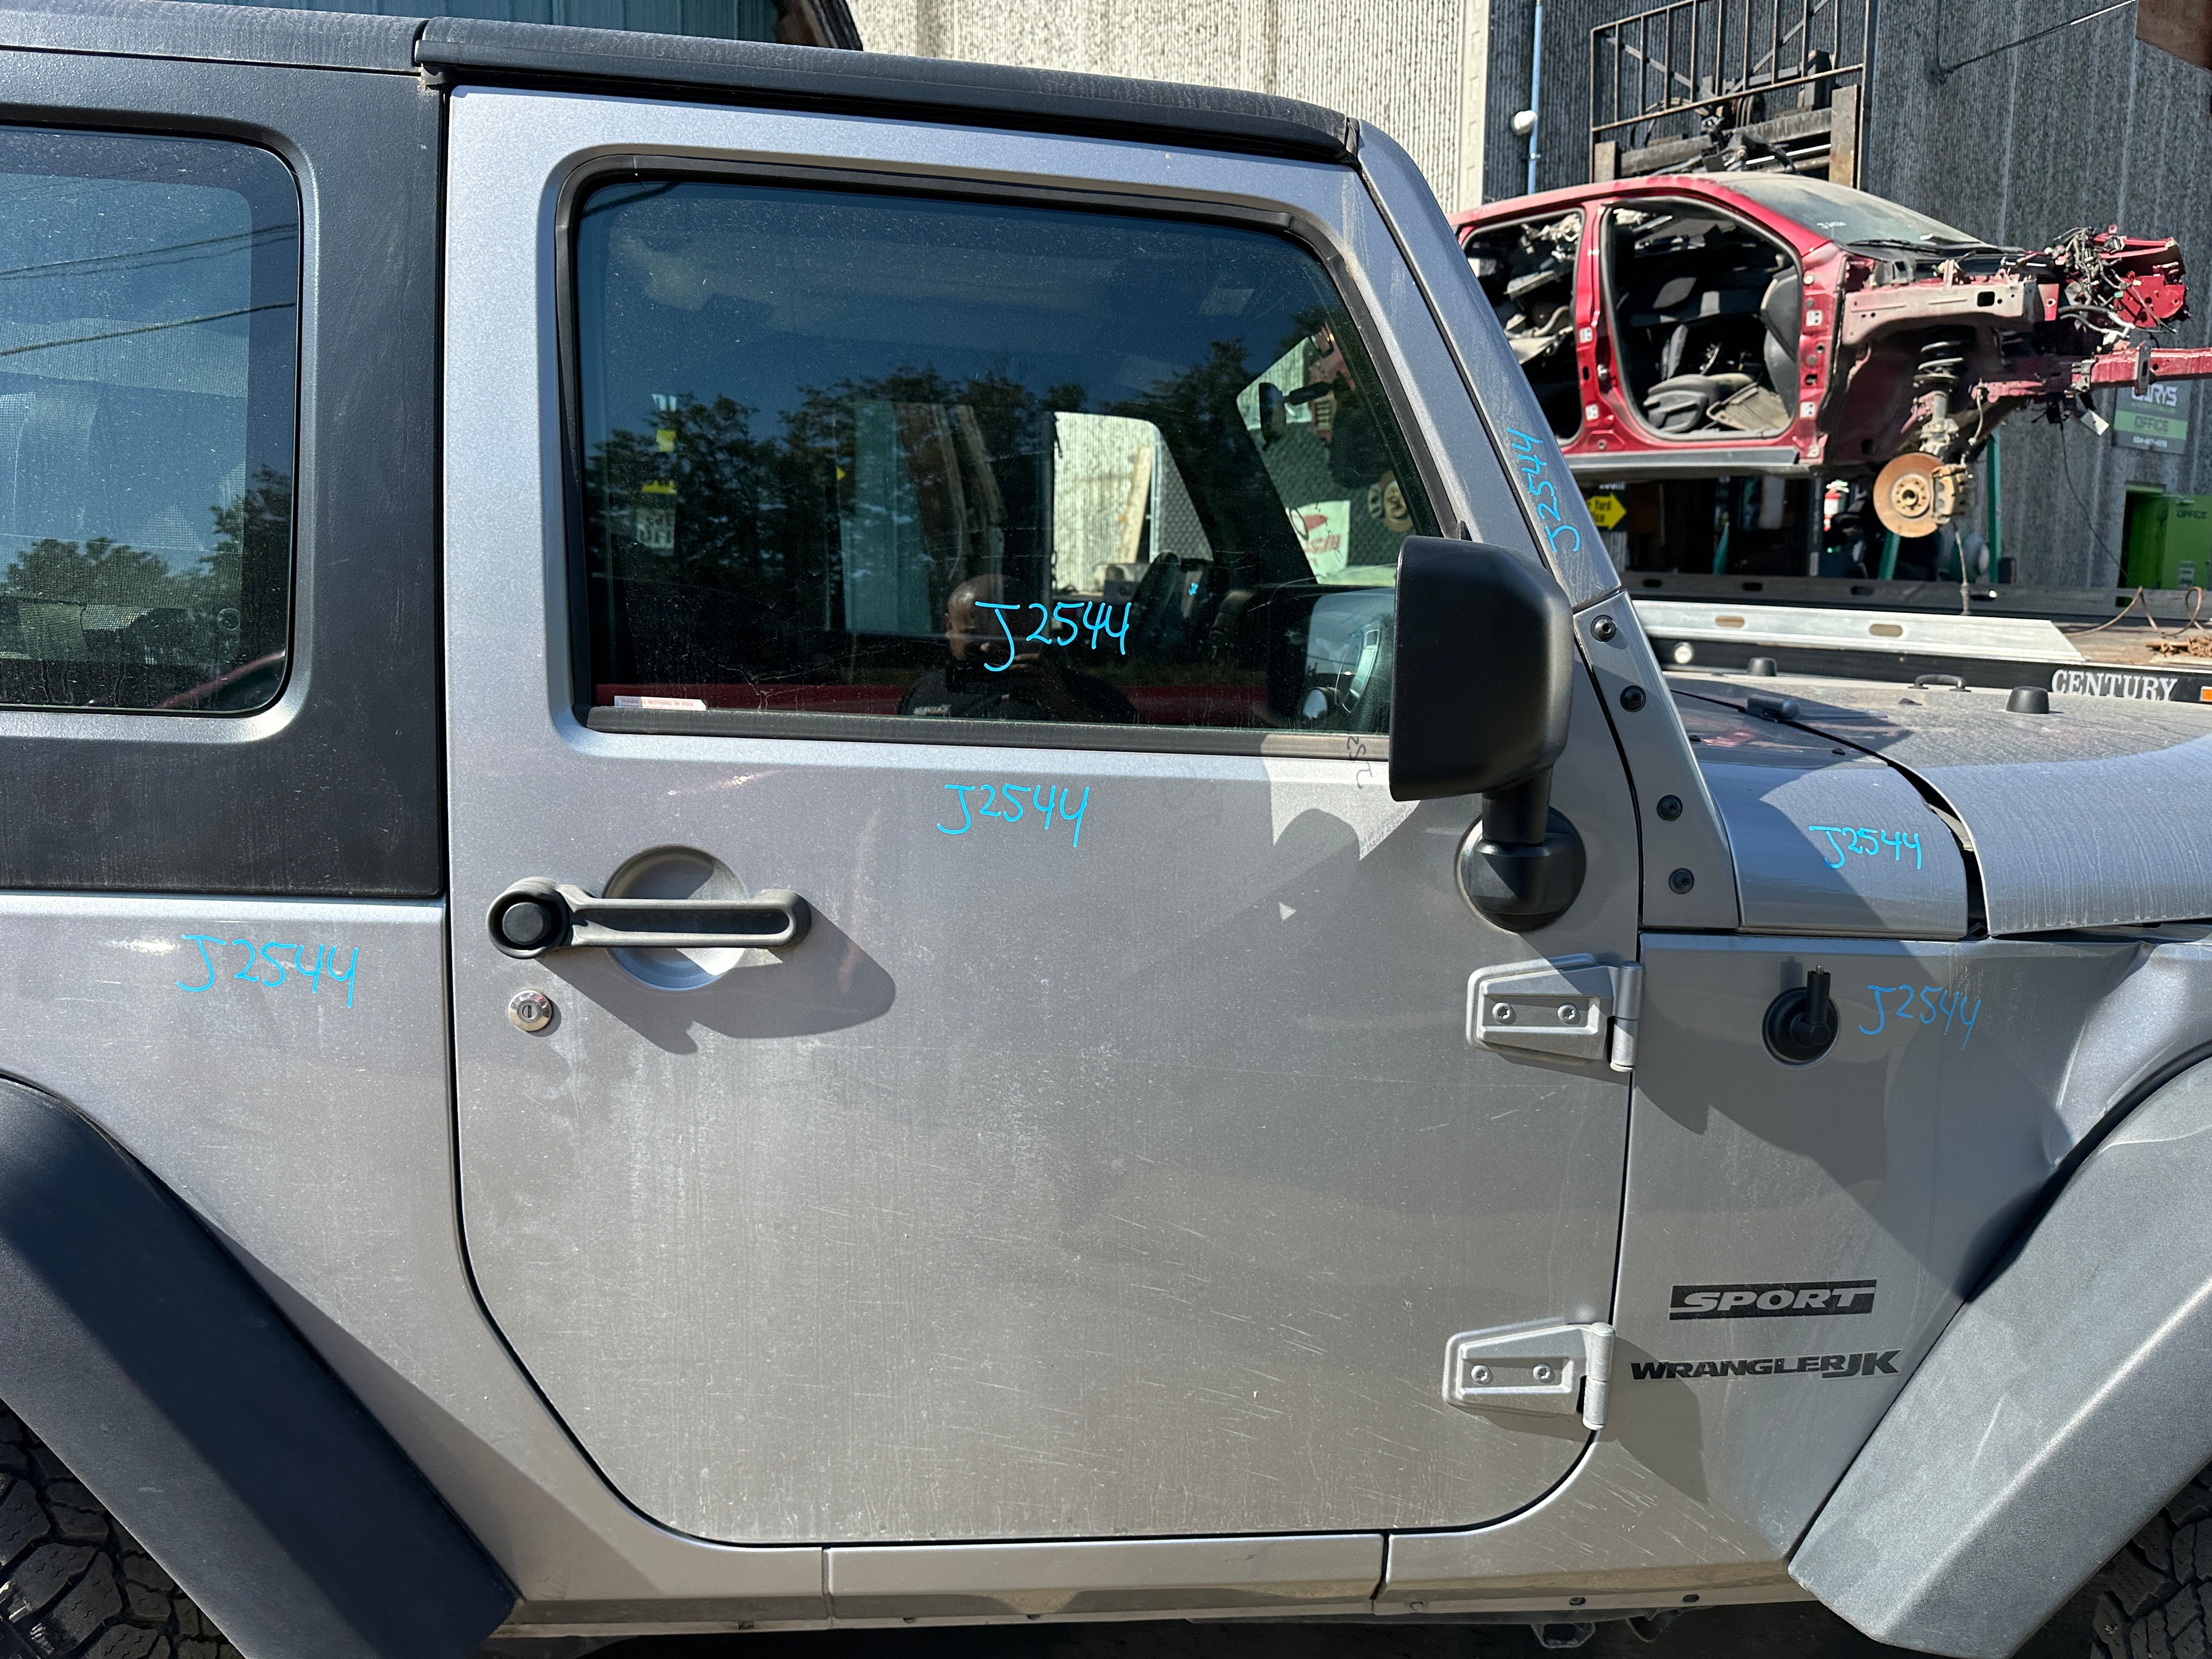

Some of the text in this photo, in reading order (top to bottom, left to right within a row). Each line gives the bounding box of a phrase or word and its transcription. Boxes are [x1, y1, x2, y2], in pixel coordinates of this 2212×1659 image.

[2134, 415, 2168, 433] OFFICE
[1506, 427, 1580, 552] J2544
[2176, 509, 2207, 520] OFFICE
[975, 601, 1132, 672] J2544
[2051, 669, 2177, 701] CENTURY
[937, 783, 1090, 848] J2544
[1808, 825, 1922, 870] J2544
[176, 934, 359, 1009] J2544
[1858, 984, 1982, 1050] J2544
[1670, 1286, 1876, 1313] SPORT
